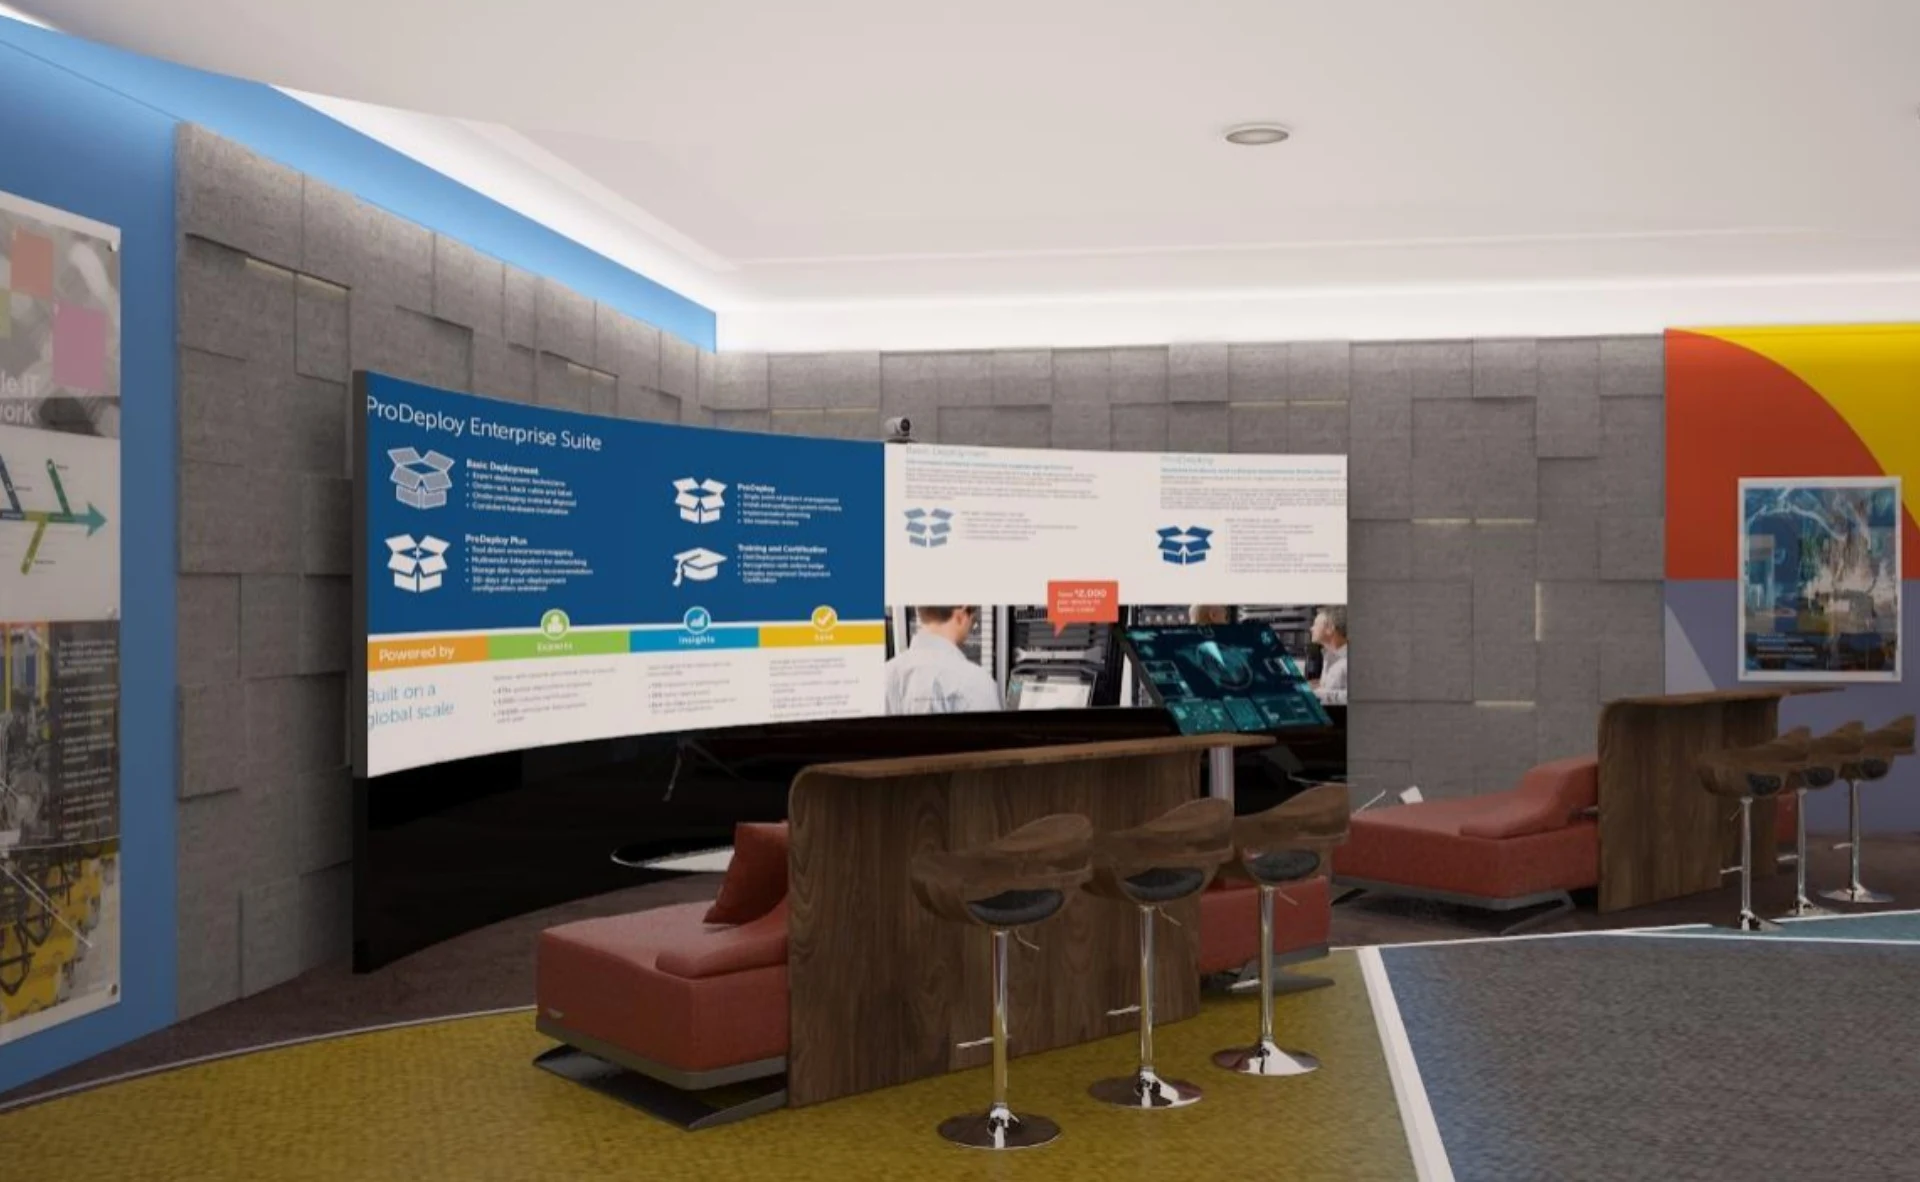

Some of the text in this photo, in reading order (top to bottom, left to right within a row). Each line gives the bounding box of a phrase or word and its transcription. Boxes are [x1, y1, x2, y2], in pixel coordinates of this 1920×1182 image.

[0, 401, 36, 426] ork
[367, 395, 603, 452] ProDeploy Enterprise Suite
[466, 459, 539, 475] Basic Deployment
[737, 482, 775, 494] ProDeploy
[465, 533, 528, 545] ProDeploy Plus
[738, 543, 828, 555] Training and Certification
[678, 633, 715, 646] Insights
[379, 643, 455, 663] Powered by
[404, 686, 424, 699] on
[427, 685, 436, 697] a
[368, 701, 455, 731] global scale
